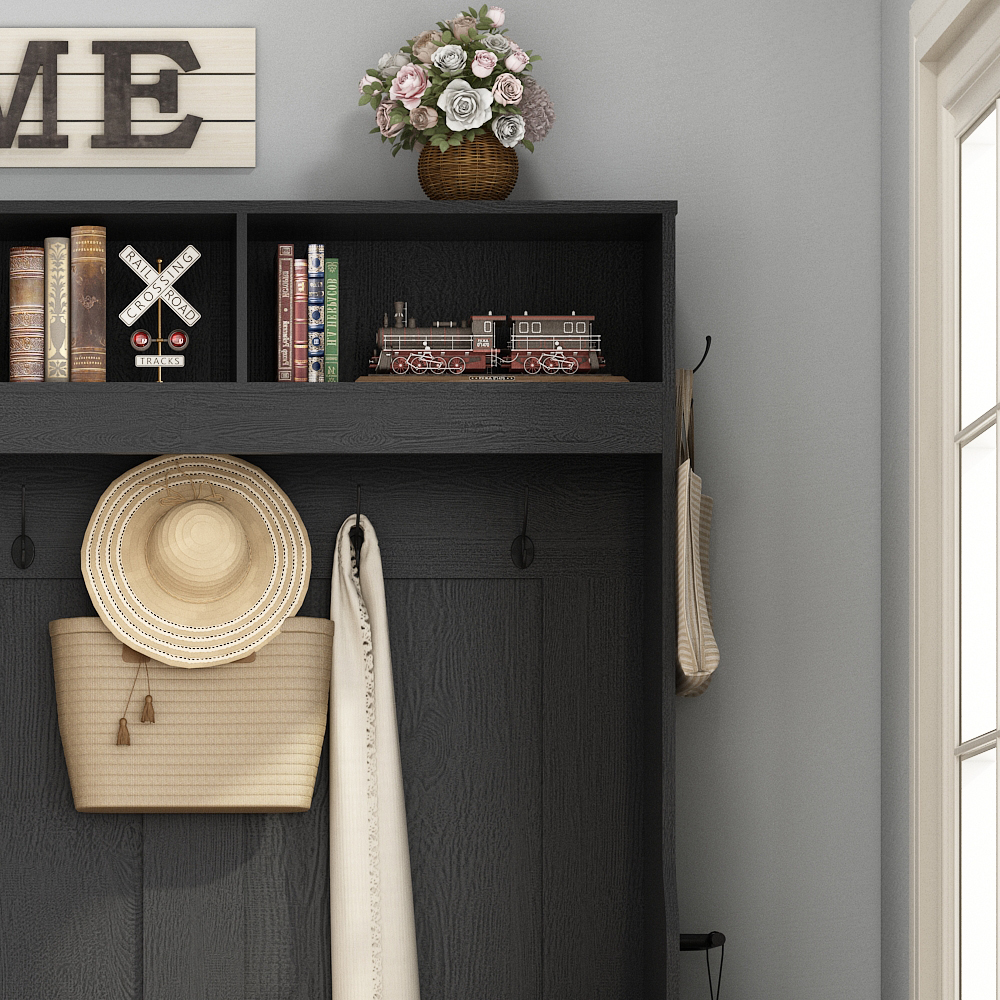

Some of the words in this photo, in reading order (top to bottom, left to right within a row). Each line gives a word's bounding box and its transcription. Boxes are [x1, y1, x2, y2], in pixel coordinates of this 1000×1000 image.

[125, 250, 152, 280] RAIL
[164, 289, 196, 320] ROAD
[126, 251, 194, 319] CROSSING
[140, 357, 180, 365] TRACKS
